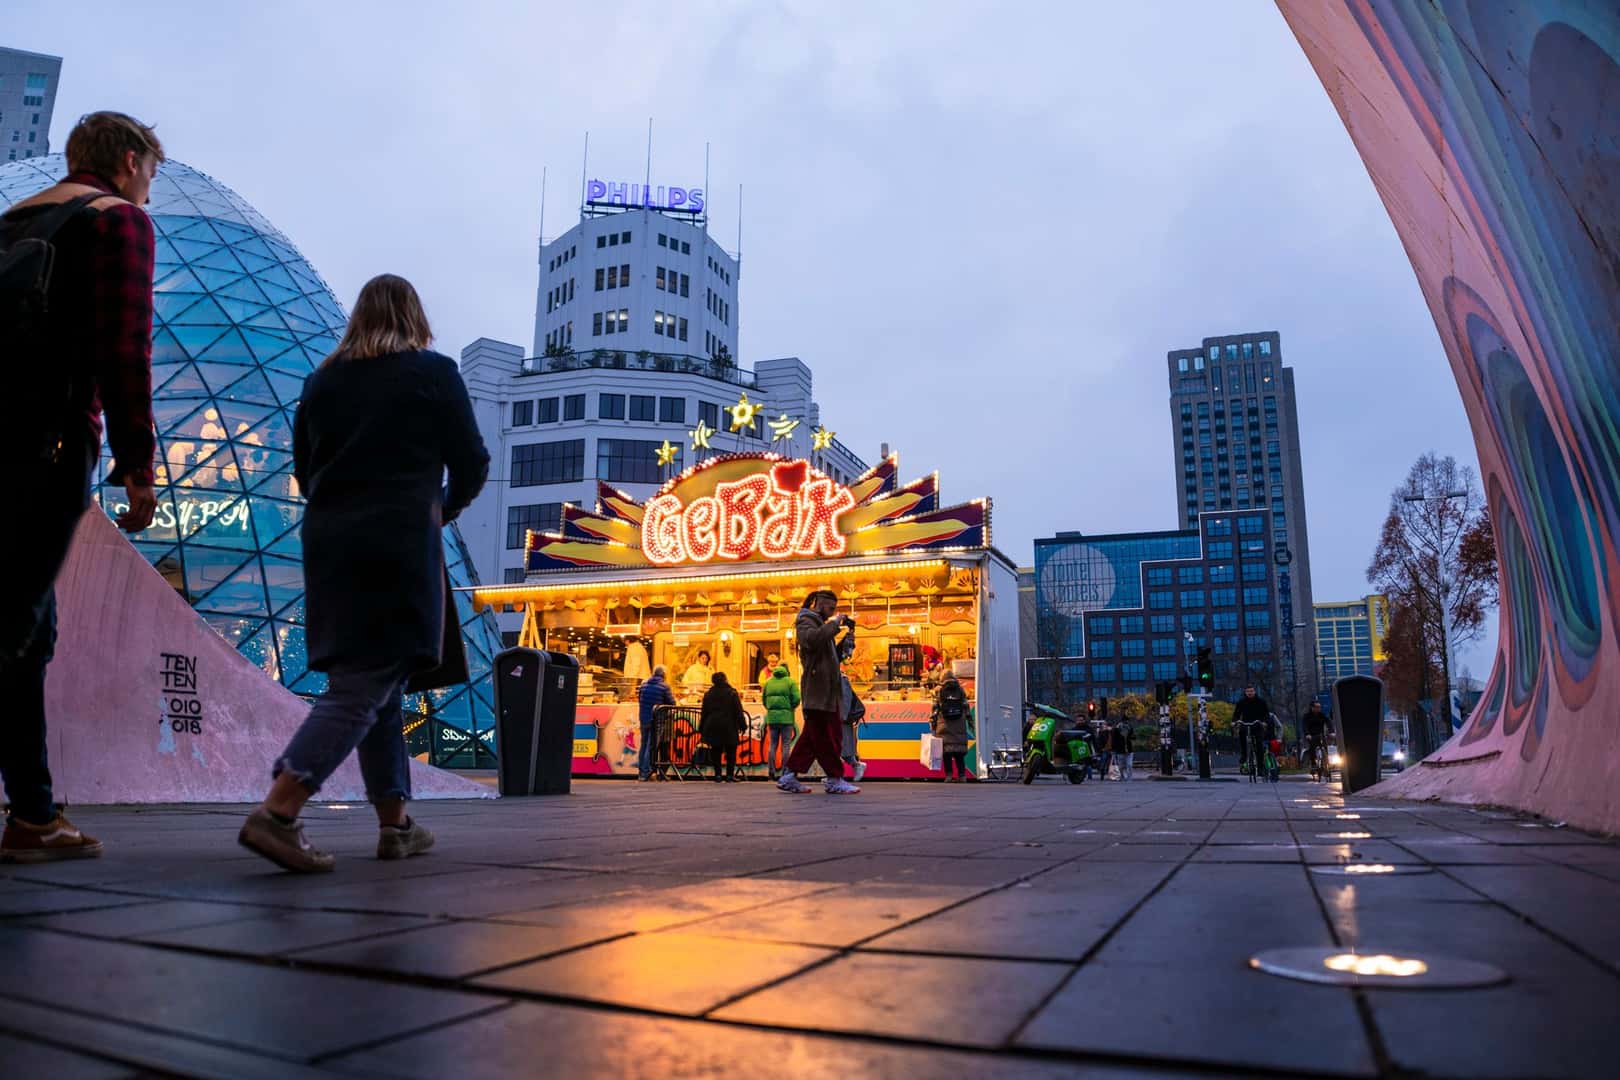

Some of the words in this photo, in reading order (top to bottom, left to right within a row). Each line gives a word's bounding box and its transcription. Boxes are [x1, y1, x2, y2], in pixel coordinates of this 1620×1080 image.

[587, 179, 705, 212] PHILIPS
[160, 652, 197, 674] TEN
[160, 671, 197, 690] TEN
[166, 697, 202, 715] 010
